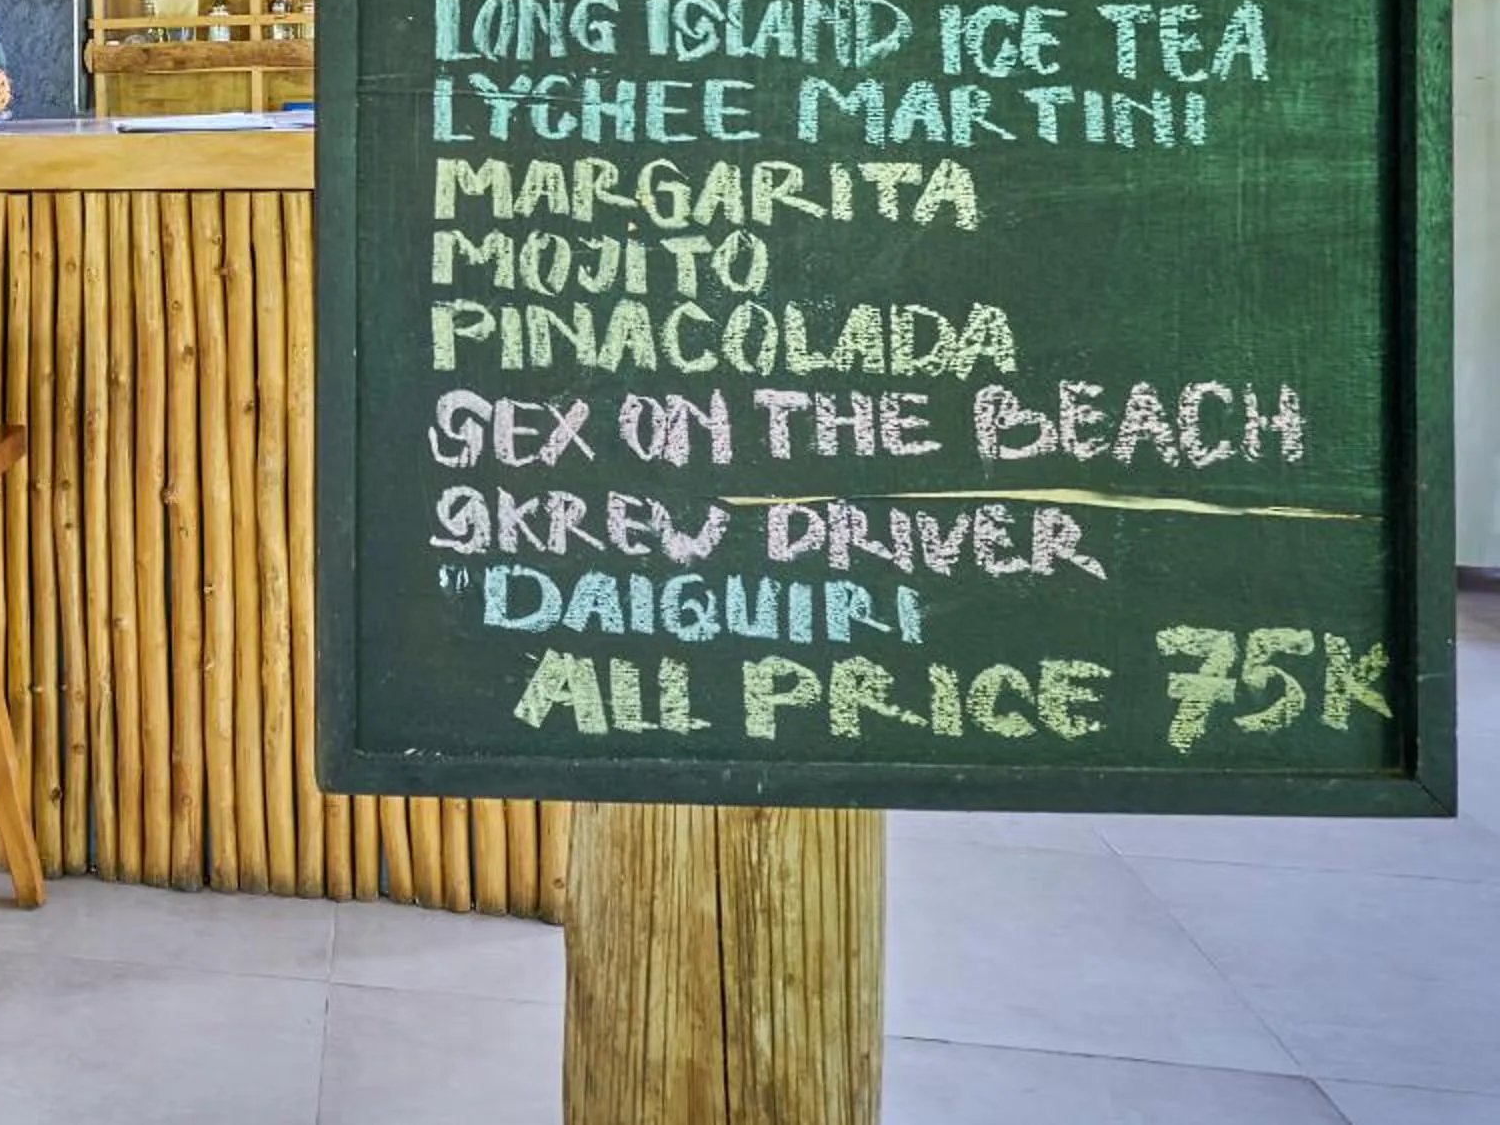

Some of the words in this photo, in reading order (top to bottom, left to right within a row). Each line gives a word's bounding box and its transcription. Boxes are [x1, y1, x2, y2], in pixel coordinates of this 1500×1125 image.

[939, 4, 1069, 77] ICE
[1097, 0, 1269, 83] TEA
[432, 72, 761, 144] LYCHEE
[796, 79, 1210, 150] MARTINI
[433, 157, 984, 232] MARGARITA
[431, 230, 773, 295] MOJITO
[428, 388, 595, 469] SEX
[619, 389, 732, 467] ON
[754, 387, 943, 459] THE
[973, 380, 1308, 469] BEACH
[429, 485, 729, 563] SKREW
[767, 498, 1108, 580] DRIVER
[512, 650, 712, 735] ALL
[741, 654, 1112, 741] PRICE
[1155, 624, 1396, 755] 75K
